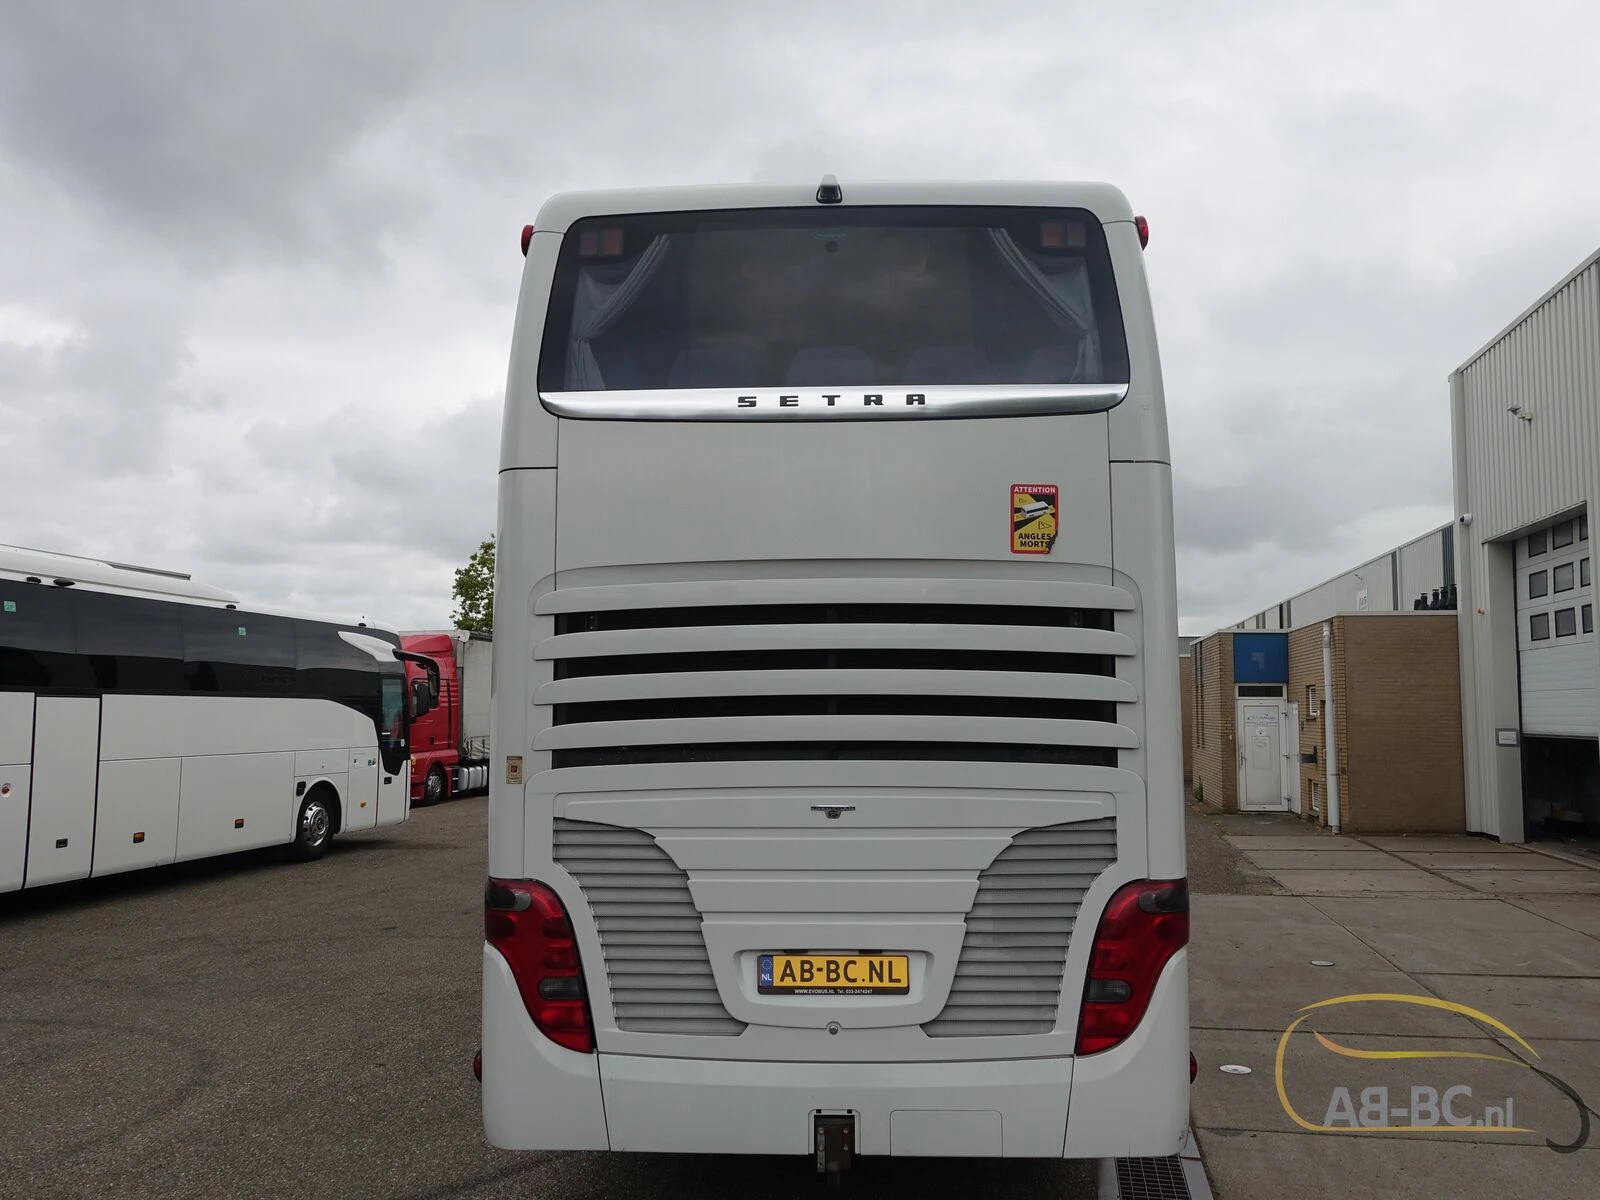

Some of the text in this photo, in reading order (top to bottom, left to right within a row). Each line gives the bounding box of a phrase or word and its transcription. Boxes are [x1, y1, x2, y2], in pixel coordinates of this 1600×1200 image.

[738, 394, 925, 407] SETRA
[762, 973, 772, 981] NL
[779, 960, 902, 983] AB-BC.NL
